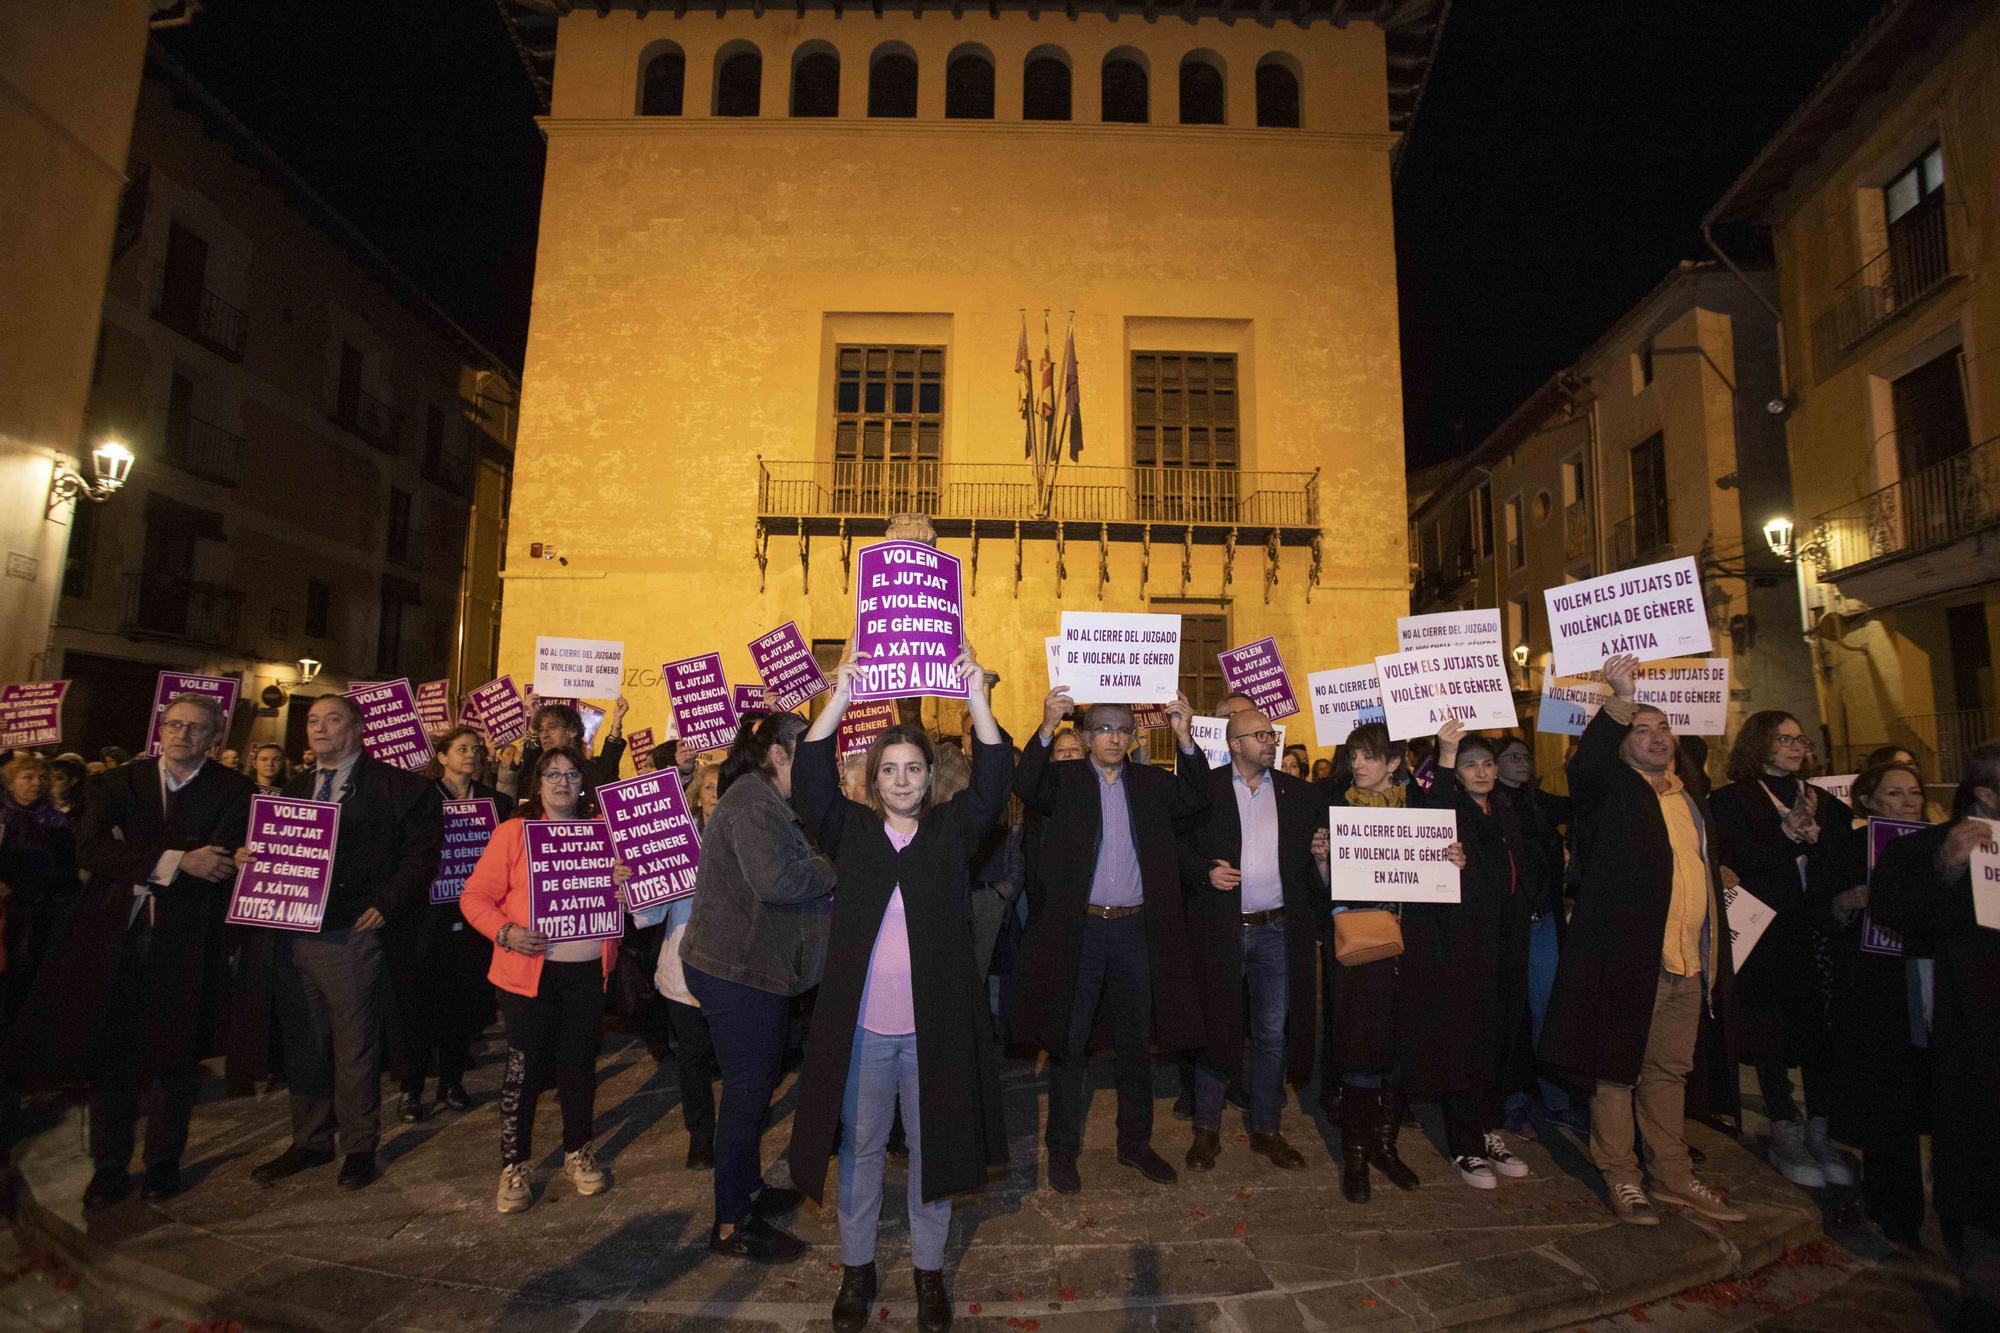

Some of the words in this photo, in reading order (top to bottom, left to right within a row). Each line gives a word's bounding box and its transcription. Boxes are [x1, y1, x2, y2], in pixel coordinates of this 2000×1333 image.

[883, 549, 938, 569] VOLEM
[872, 573, 890, 588] EL
[894, 571, 948, 591] JUTJAT
[1553, 591, 1592, 613] VOLEM
[1595, 585, 1616, 603] ELS
[1619, 574, 1672, 598] JUTJATS
[1675, 569, 1693, 586] DE
[860, 597, 878, 614] DE
[881, 592, 960, 617] VIOLÈNCIA
[867, 619, 887, 635] DE
[891, 615, 953, 636] GÈNERE
[1560, 611, 1622, 638] VIOLÈNCIA
[1625, 606, 1641, 624] DE
[1644, 597, 1695, 620] GÈNERE
[1067, 628, 1079, 641] NO
[1081, 628, 1092, 642] AL
[1094, 629, 1123, 642] CIERRE
[1125, 629, 1140, 643] DEL
[1141, 630, 1177, 643] JUZGADO
[1402, 630, 1412, 640] NO
[1413, 629, 1421, 638] AL
[1422, 626, 1447, 637] CIERRE
[1449, 624, 1461, 635] DEL
[1464, 622, 1498, 634] JUZGADO
[760, 630, 786, 650] VOLEM
[873, 643, 885, 658] A
[888, 638, 946, 657] XÀTIVA
[1601, 641, 1610, 657] A
[1612, 632, 1658, 654] XÀTIVA
[540, 648, 549, 657] NO
[559, 649, 581, 659] CIERRE
[582, 650, 593, 660] DEL
[594, 651, 621, 661] JUZGADO
[760, 653, 770, 663] EL
[770, 640, 796, 658] JUTJAT
[1068, 651, 1078, 664] DE
[1083, 652, 1126, 665] VIOLENCIA
[1129, 653, 1140, 665] DE
[1143, 650, 1174, 666] GÉNERO
[1233, 646, 1263, 662] VOLEM
[541, 663, 549, 672] DE
[551, 663, 583, 674] VIOLENCIA
[585, 665, 593, 674] DE
[596, 666, 619, 676] GÉNERO
[677, 660, 707, 675] VOLEM
[760, 666, 770, 677] DE
[769, 648, 808, 672] VIOLÈNCIA
[1232, 666, 1243, 675] EL
[1244, 656, 1272, 672] JUTJAT
[1384, 662, 1419, 680] VOLEM
[1421, 659, 1440, 673] ELS
[1443, 656, 1485, 671] JUTJATS
[1486, 654, 1500, 668] DE
[675, 681, 686, 690] EL
[686, 673, 715, 688] JUTJAT
[768, 676, 780, 687] DE
[779, 661, 809, 680] GÈNERE
[783, 673, 811, 690] XÀTIVA
[861, 663, 906, 692] TOTES
[909, 661, 922, 688] A
[925, 661, 962, 690] UNA!
[1100, 674, 1110, 687] EN
[1112, 671, 1142, 687] XÀTIVA
[1230, 681, 1241, 689] DE
[1241, 665, 1283, 685] VIOLÈNCIA
[1648, 668, 1666, 680] ELS
[1669, 668, 1710, 680] JUTJATS
[1712, 668, 1724, 680] DE
[180, 679, 219, 691] VOLEM
[564, 679, 571, 688] EN
[804, 677, 826, 696] UNA!
[1251, 678, 1282, 695] GÈNERE
[1315, 685, 1326, 696] NO
[1328, 684, 1338, 695] AL
[1340, 679, 1367, 693] CIERRE
[1391, 683, 1447, 703] VIOLÈNCIA
[1448, 682, 1463, 695] DE
[1464, 677, 1503, 694] GÈNERE
[356, 688, 393, 704] VOLEM
[672, 697, 683, 706] DE
[683, 686, 727, 703] VIOLÈNCIA
[1254, 691, 1283, 706] XÀTIVA
[1549, 686, 1587, 703] VIOLÈNCIA
[1670, 690, 1682, 702] DE
[1685, 688, 1721, 703] GÈNERE
[369, 700, 403, 716] JUTJAT
[680, 709, 691, 719] DE
[692, 702, 725, 717] GÈNERE
[848, 704, 891, 720] VIOLÈNCIA
[1275, 698, 1296, 716] UNA!
[1320, 704, 1330, 714] DE
[1333, 698, 1374, 713] VIOLENCIA
[1430, 709, 1437, 723] A
[1440, 704, 1477, 722] XÀTIVA
[366, 711, 418, 731] VIOLÈNCIA
[694, 716, 726, 731] XÀTIVA
[855, 719, 888, 732] GÈNERE
[363, 736, 377, 747] DE
[377, 727, 416, 743] GÈNERE
[381, 741, 416, 757] XÀTIVA
[406, 749, 431, 768] UNA!
[618, 780, 660, 801] VOLEM
[273, 805, 318, 821] VOLEM
[616, 809, 631, 822] EL
[632, 797, 672, 817] JUTJAT
[450, 817, 486, 828] JUTJAT
[613, 831, 628, 843] DE
[628, 814, 690, 839] VIOLÈNCIA
[1336, 823, 1349, 836] NO
[1351, 824, 1362, 837] AL
[1364, 824, 1395, 838] CIERRE
[1397, 825, 1413, 838] DEL
[1415, 826, 1453, 839] JUZGADO
[262, 823, 277, 834] EL
[280, 825, 324, 840] JUTJAT
[547, 826, 594, 837] VOLEM
[250, 841, 266, 853] DE
[268, 843, 330, 860] VIOLÈNCIA
[541, 843, 558, 854] EL
[560, 841, 604, 853] JUTJAT
[624, 847, 641, 860] DE
[642, 833, 689, 855] GÈNERE
[1339, 847, 1350, 859] DE
[1353, 847, 1400, 861] VIOLENCIA
[1404, 848, 1415, 861] DE
[253, 861, 272, 873] DE
[272, 861, 320, 879] GÈNERE
[532, 861, 549, 873] DE
[648, 853, 690, 873] XÀTIVA
[542, 880, 560, 892] DE
[562, 875, 611, 890] GÈNERE
[1374, 870, 1386, 883] EN
[1388, 868, 1419, 884] XÀTIVA
[253, 881, 263, 892] A
[265, 881, 309, 897] XÀTIVA
[630, 874, 670, 903] TOTES
[237, 896, 276, 920] TOTES
[274, 900, 286, 922] A
[287, 902, 319, 925] UNA!
[549, 900, 559, 911] A
[561, 896, 605, 910] XÀTIVA
[537, 914, 576, 938] TOTES
[578, 914, 587, 935] A
[590, 911, 617, 934] UNA!
